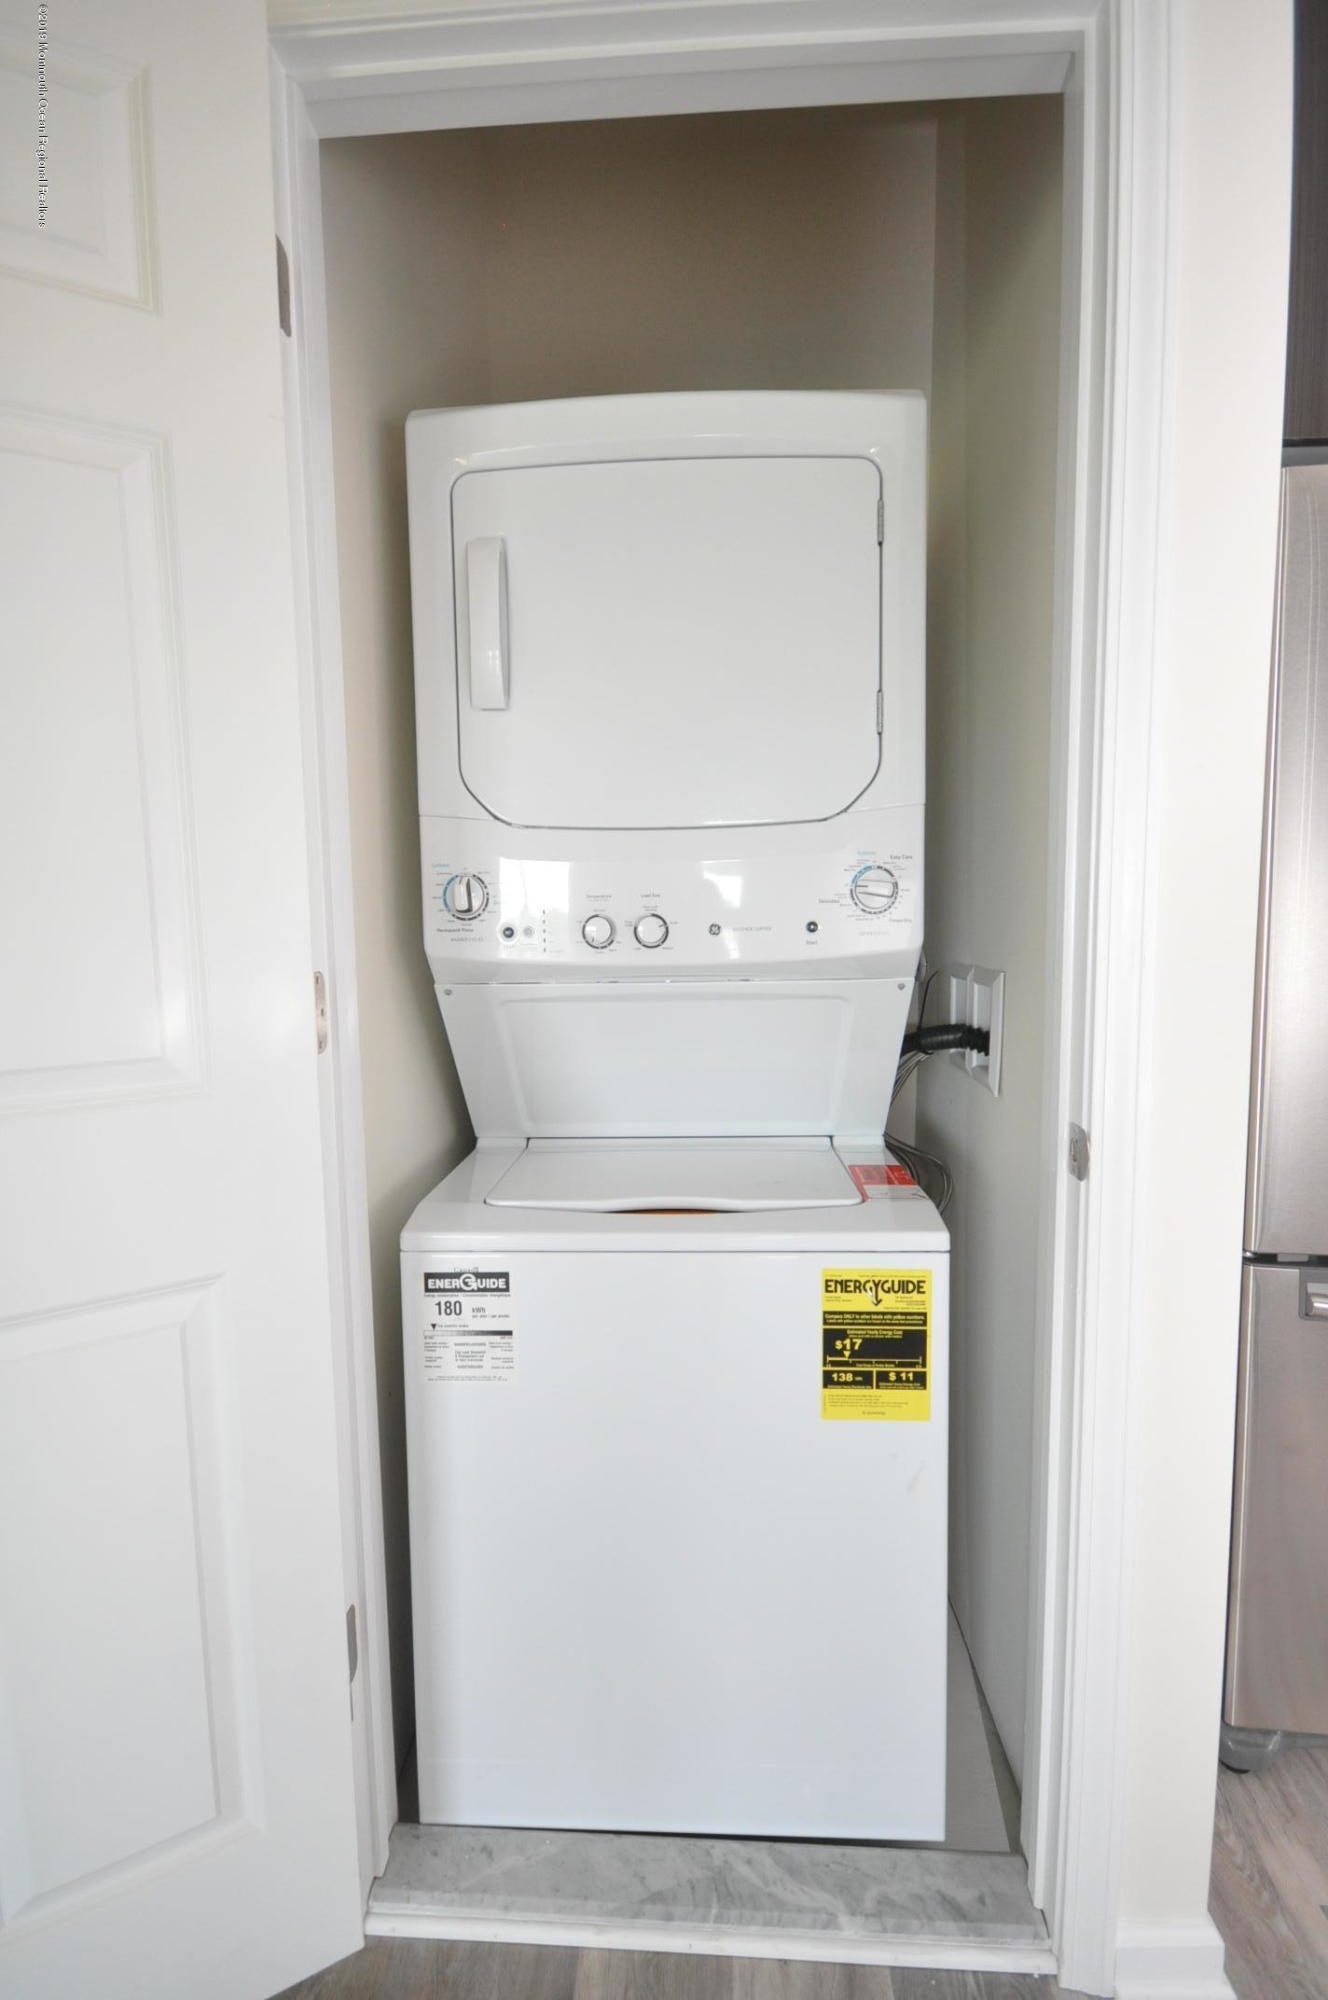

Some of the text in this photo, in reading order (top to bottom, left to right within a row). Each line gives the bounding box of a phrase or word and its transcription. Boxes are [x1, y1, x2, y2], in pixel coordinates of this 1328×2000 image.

[428, 1273, 507, 1291] ENERGUIDE
[825, 1279, 926, 1299] ENERGYGUIDE
[434, 1300, 462, 1316] 180
[834, 1338, 862, 1351] $17
[832, 1372, 853, 1382] 138
